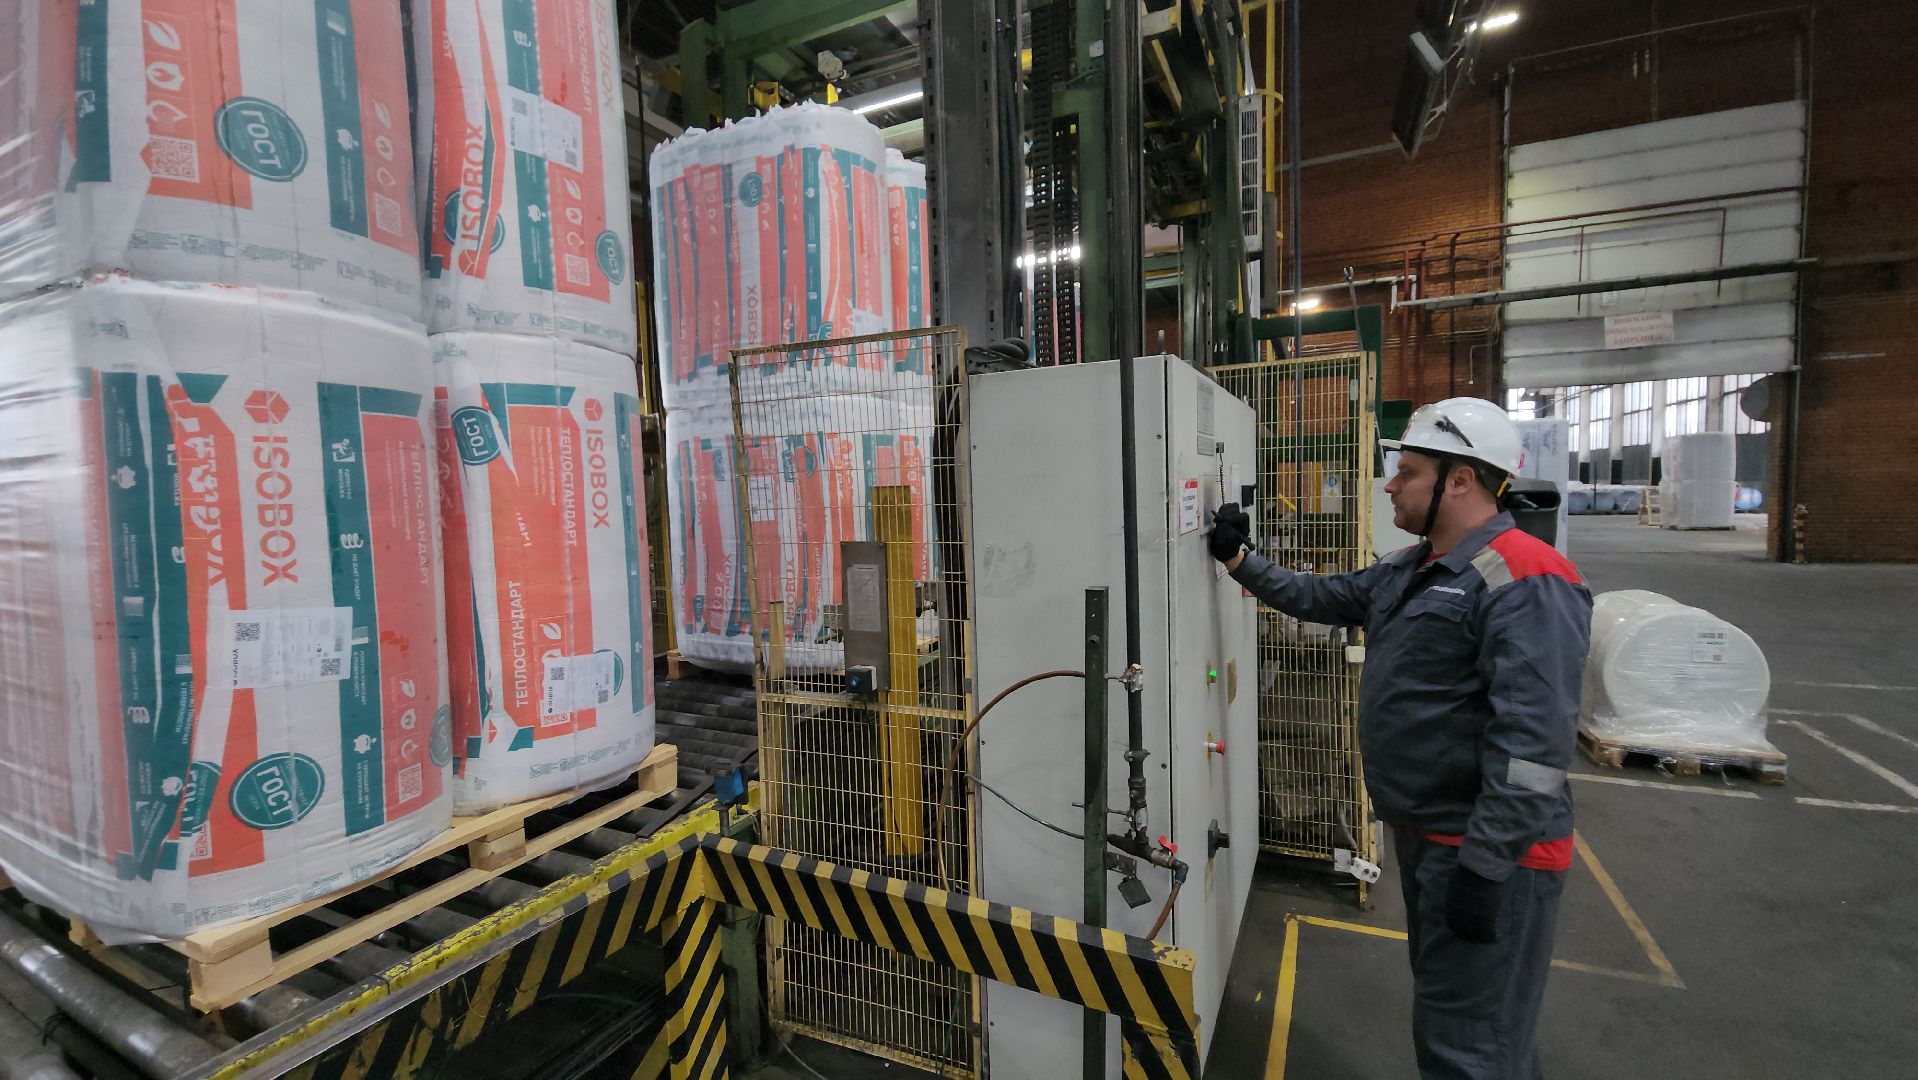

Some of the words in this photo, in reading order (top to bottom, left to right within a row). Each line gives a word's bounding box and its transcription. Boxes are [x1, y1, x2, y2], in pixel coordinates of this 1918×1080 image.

[240, 109, 282, 170] ГОСТ
[605, 236, 620, 277] ГОСТ
[746, 284, 758, 346] SOBOX
[463, 417, 489, 458] ГОСТ
[252, 435, 298, 587] ISOBOX
[412, 443, 429, 587] ТЕПЛОСТАНДАРТ
[560, 427, 577, 546] ТЕПЛОСТАНДАРТ
[586, 429, 610, 529] ISOBOX
[508, 581, 528, 707] ТЕПЛОСТАНДАРТ
[256, 766, 294, 816] ГОСТ
